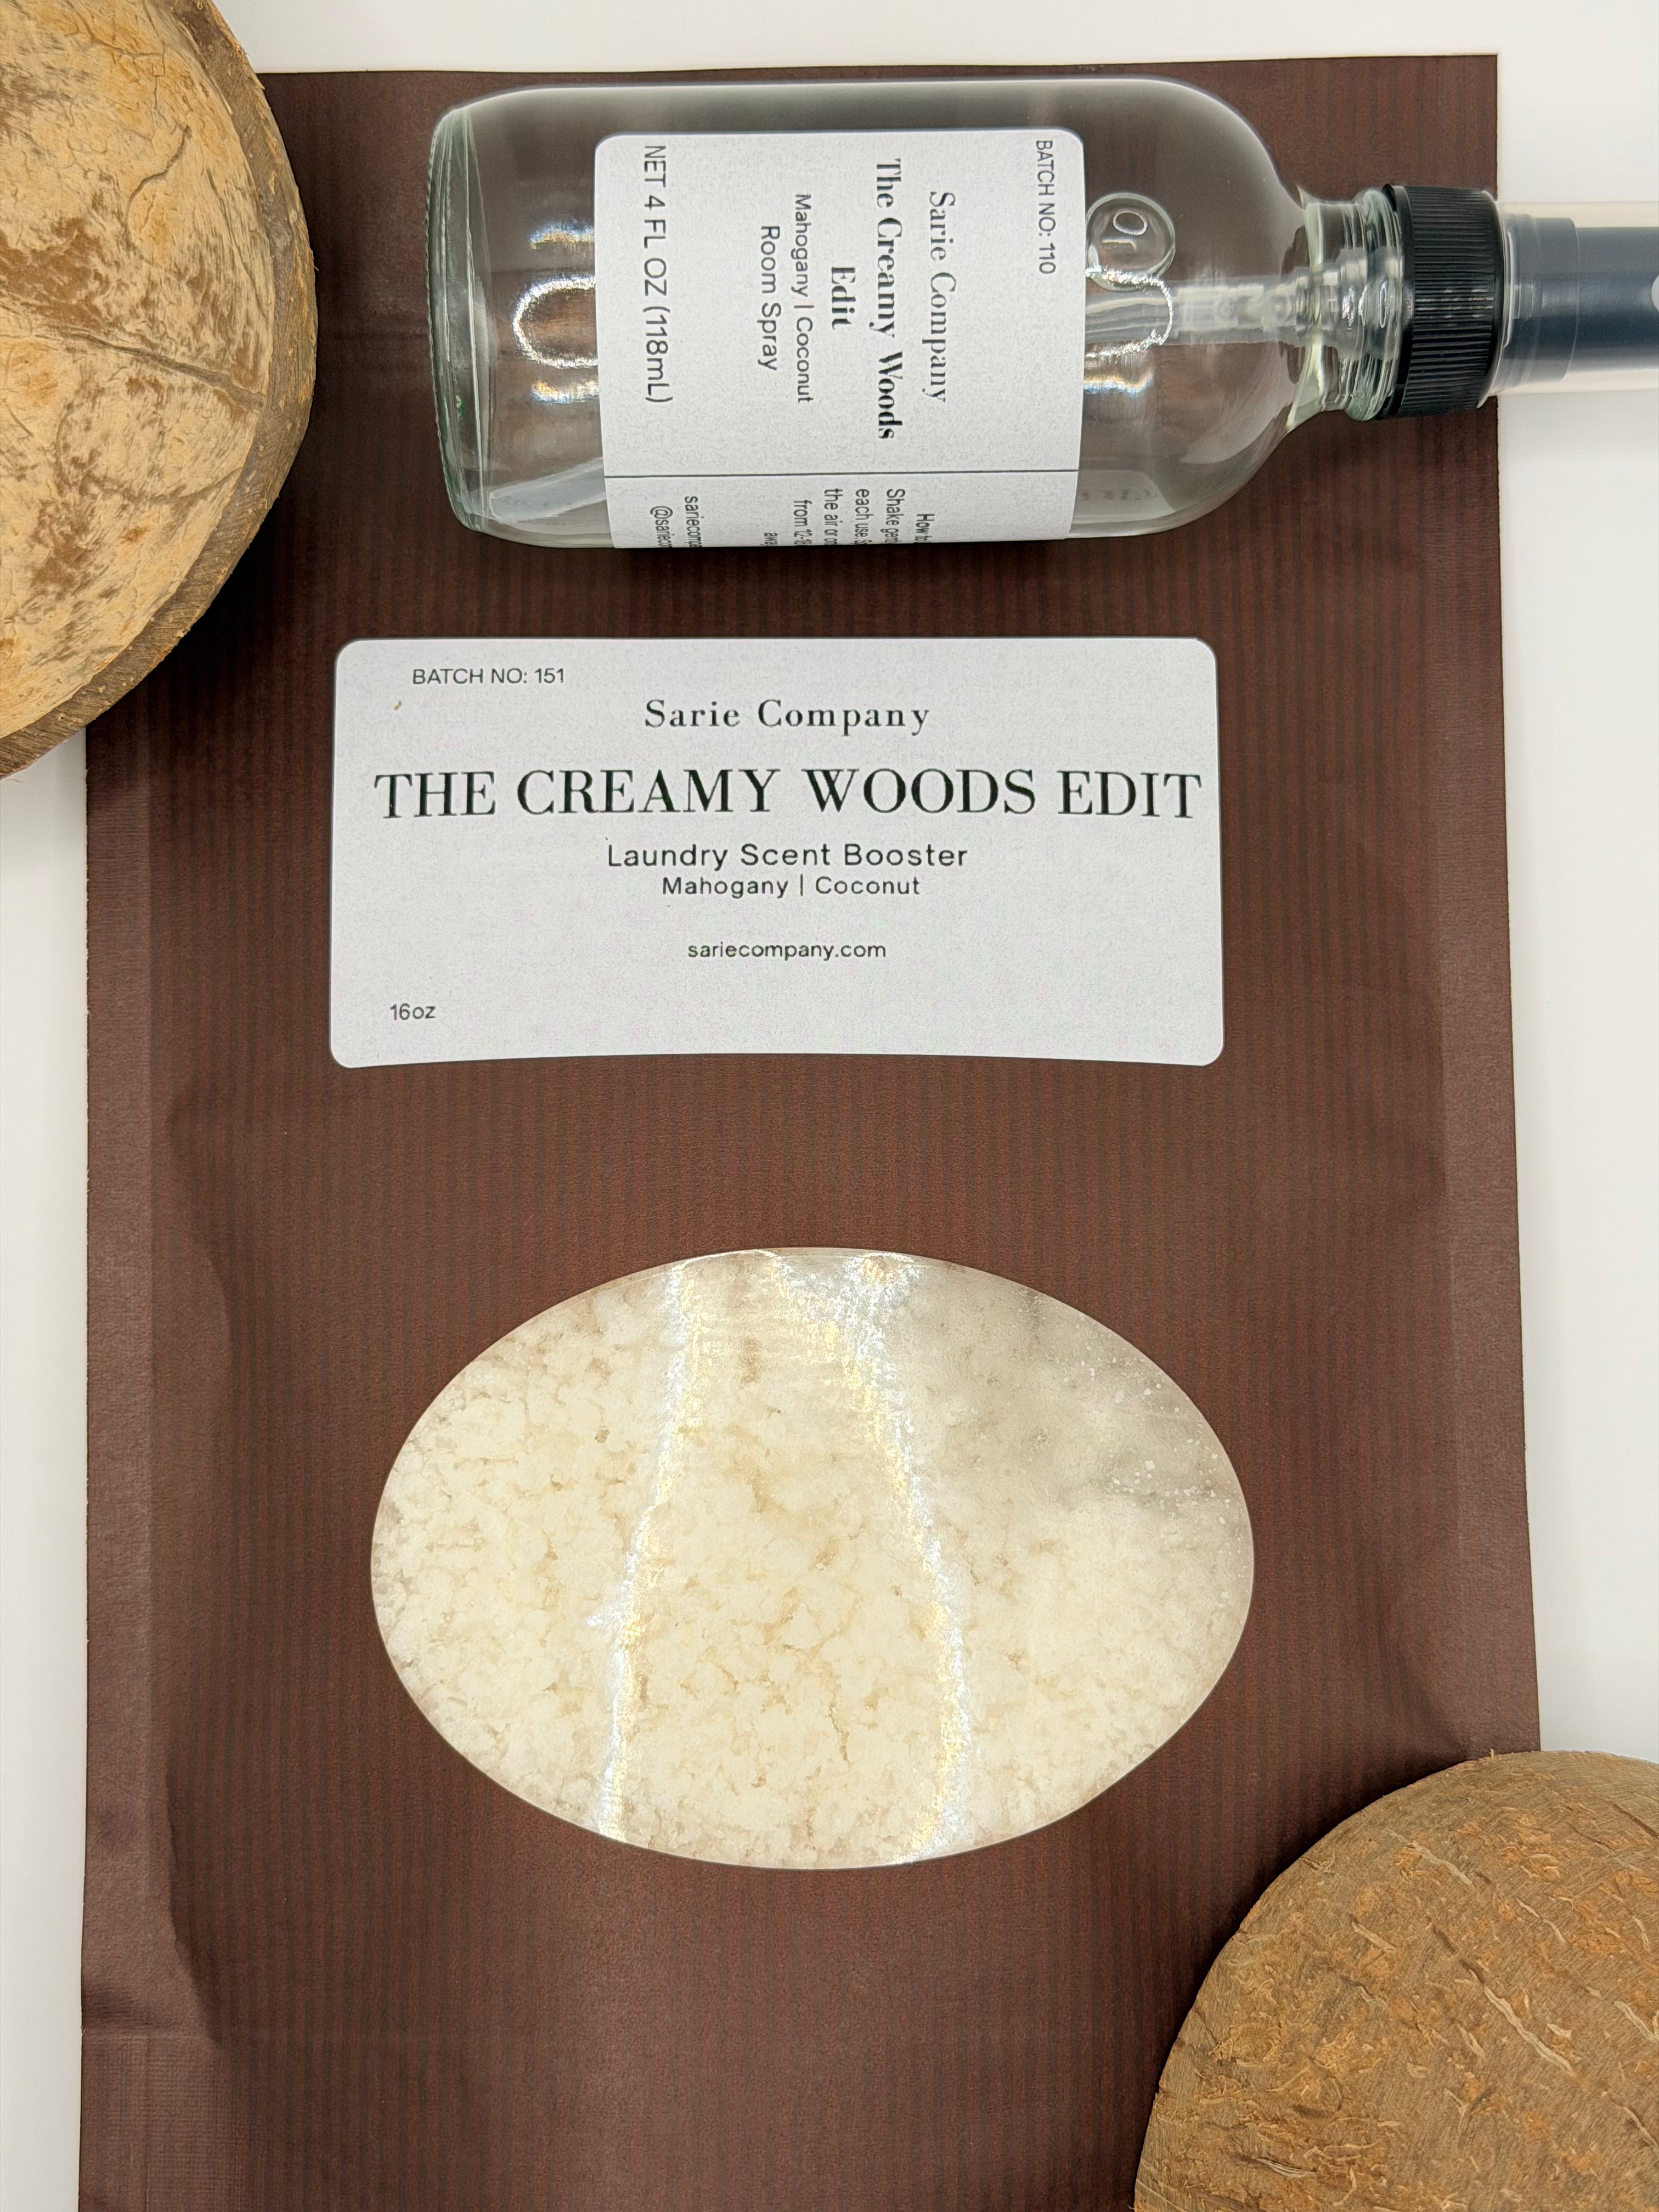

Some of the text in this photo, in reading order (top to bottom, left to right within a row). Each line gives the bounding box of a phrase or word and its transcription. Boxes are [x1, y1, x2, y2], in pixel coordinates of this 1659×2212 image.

[1035, 140, 1057, 274] BATCH NO: 110
[790, 194, 812, 297] Mahogany
[642, 145, 674, 403] NET 4 FL OZ (118mL)
[757, 225, 782, 371] Room Spray
[831, 266, 856, 330] Edit
[868, 157, 904, 439] The Creamy Woods
[921, 191, 957, 403] Sarie Company
[796, 317, 814, 404] Coconut
[793, 499, 812, 527] from
[823, 488, 844, 510] the
[854, 488, 874, 521] each
[885, 488, 906, 526] Shake
[823, 514, 843, 527] air
[823, 529, 838, 537] or
[854, 523, 869, 539] use.
[915, 513, 935, 534] How
[413, 668, 564, 685] BATCH NO: 151
[645, 699, 930, 737] Sarie Company
[374, 768, 1202, 819] THE CREAMY WOODS EDIT
[608, 843, 968, 872] Laundry Scent Booster
[662, 876, 789, 899] Mahogany
[815, 876, 921, 895] Coconut
[688, 940, 886, 962] sariecompany.com
[390, 1003, 436, 1021] 16oz
